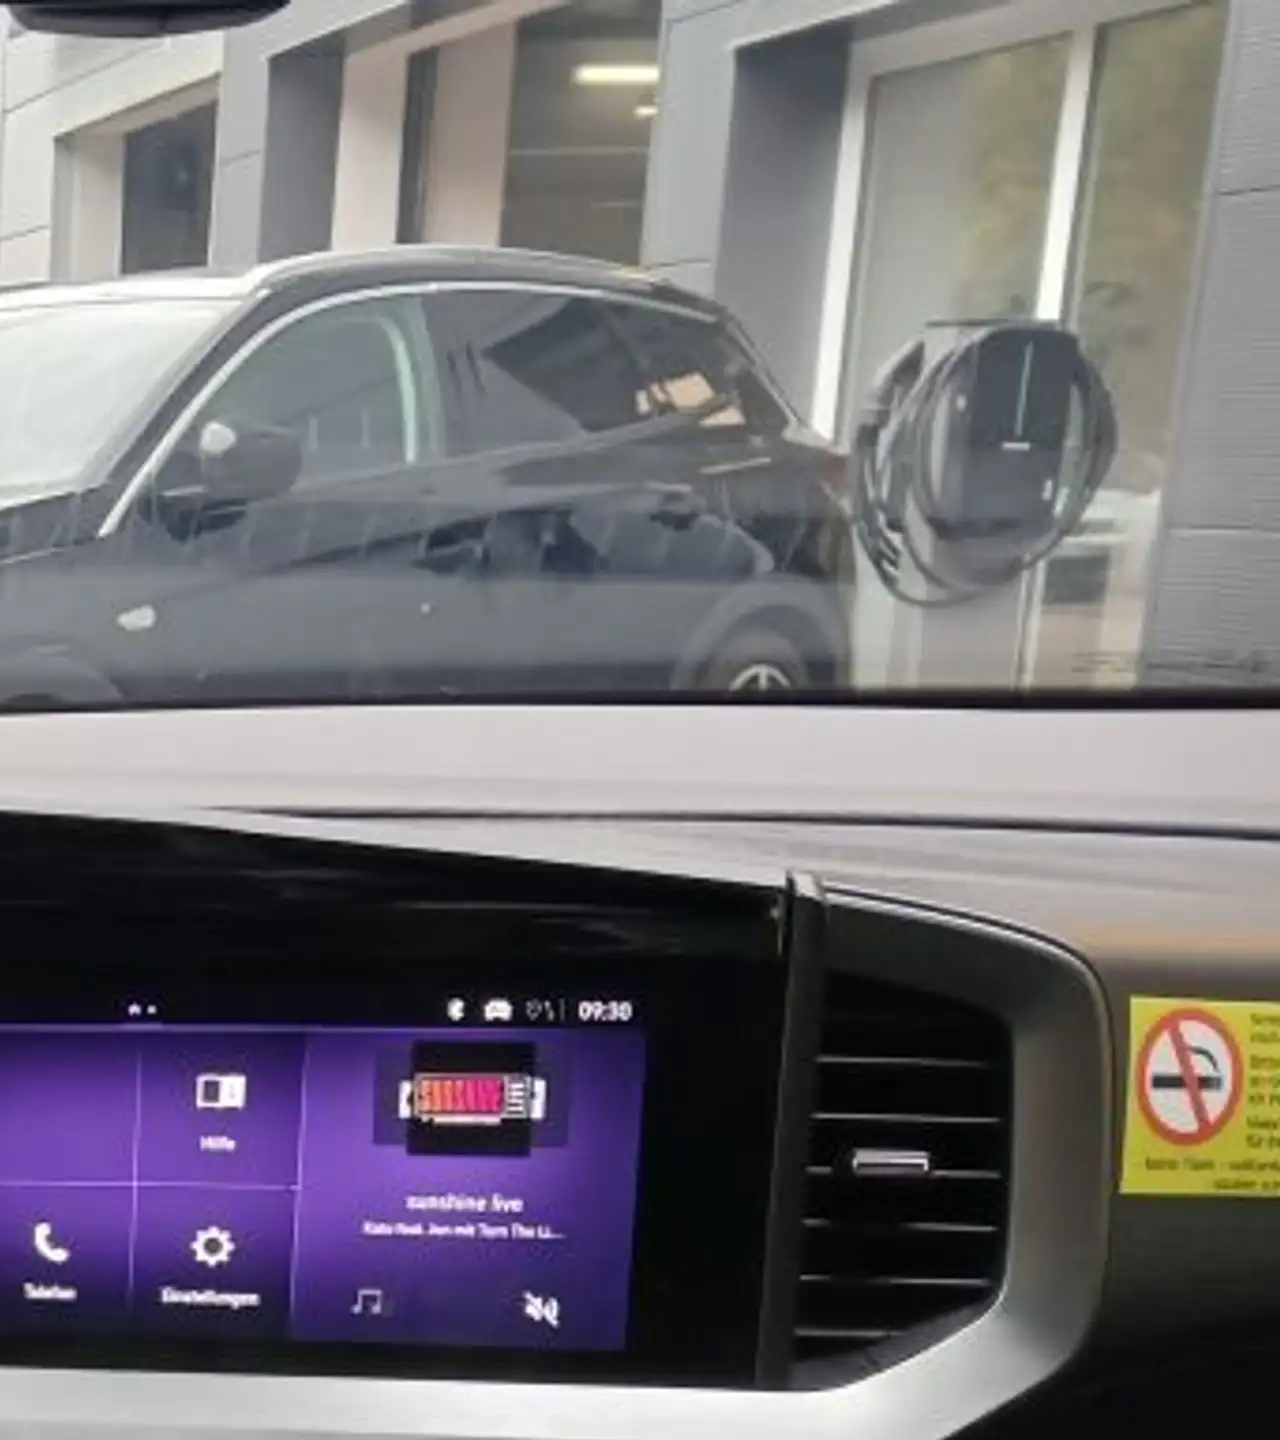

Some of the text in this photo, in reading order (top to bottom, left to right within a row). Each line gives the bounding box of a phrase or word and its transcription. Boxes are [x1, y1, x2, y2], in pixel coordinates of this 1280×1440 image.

[578, 1001, 633, 1021] 09:30
[405, 1192, 524, 1213] sunshine live
[478, 1222, 508, 1239] Turn
[511, 1223, 534, 1239] The
[161, 1286, 260, 1309] Einstellungen
